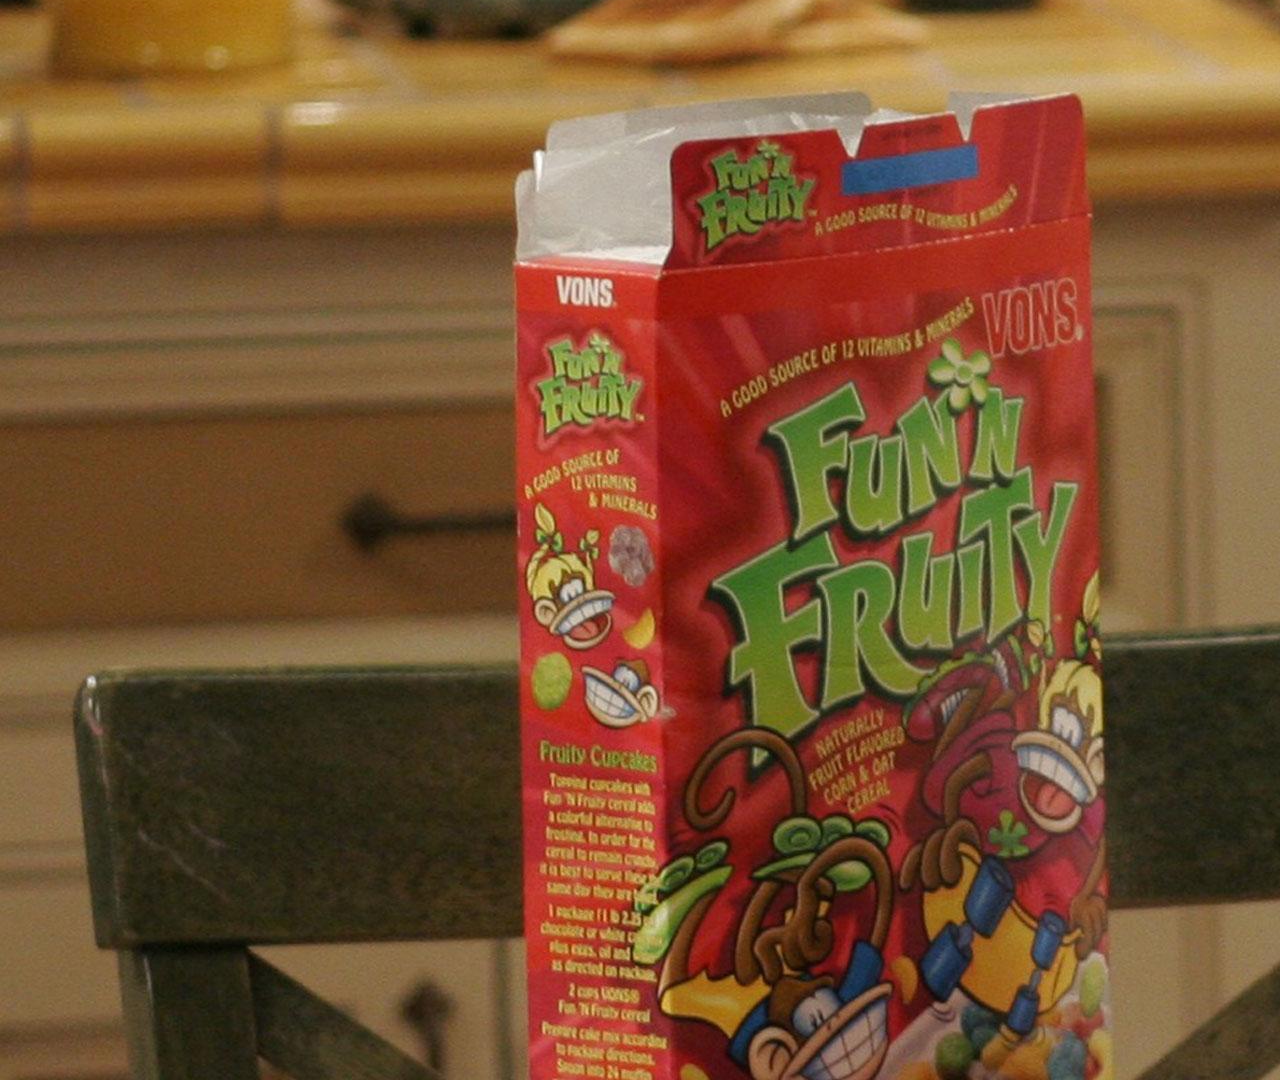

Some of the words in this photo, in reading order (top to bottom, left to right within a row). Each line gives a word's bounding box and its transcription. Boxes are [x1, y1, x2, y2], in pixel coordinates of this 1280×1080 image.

[825, 209, 856, 234] GOOD
[858, 203, 898, 224] SOURCE
[899, 203, 913, 220] OF
[719, 399, 732, 418] A
[732, 375, 768, 409] GOOD
[769, 348, 820, 389] SOURCE
[821, 342, 837, 365] OF
[842, 339, 855, 360] 12
[857, 332, 912, 357] VITAMINS
[914, 328, 925, 349] &
[925, 296, 975, 343] MINERALS
[533, 466, 561, 491] GOOD
[562, 450, 604, 475] SOURCE
[605, 448, 620, 466] OF
[571, 475, 582, 491] 12
[584, 474, 637, 493] VITAMINS
[588, 492, 598, 509] &
[601, 493, 657, 521] MINERALS
[815, 708, 884, 760] NATURALLY
[540, 739, 586, 765] Fruity
[590, 744, 658, 773] Cupcakes
[808, 753, 844, 791] FRUIT
[845, 726, 906, 765] FLAVORED
[824, 771, 857, 806] CORN
[872, 751, 896, 776] OAT
[846, 777, 891, 814] CEREAL
